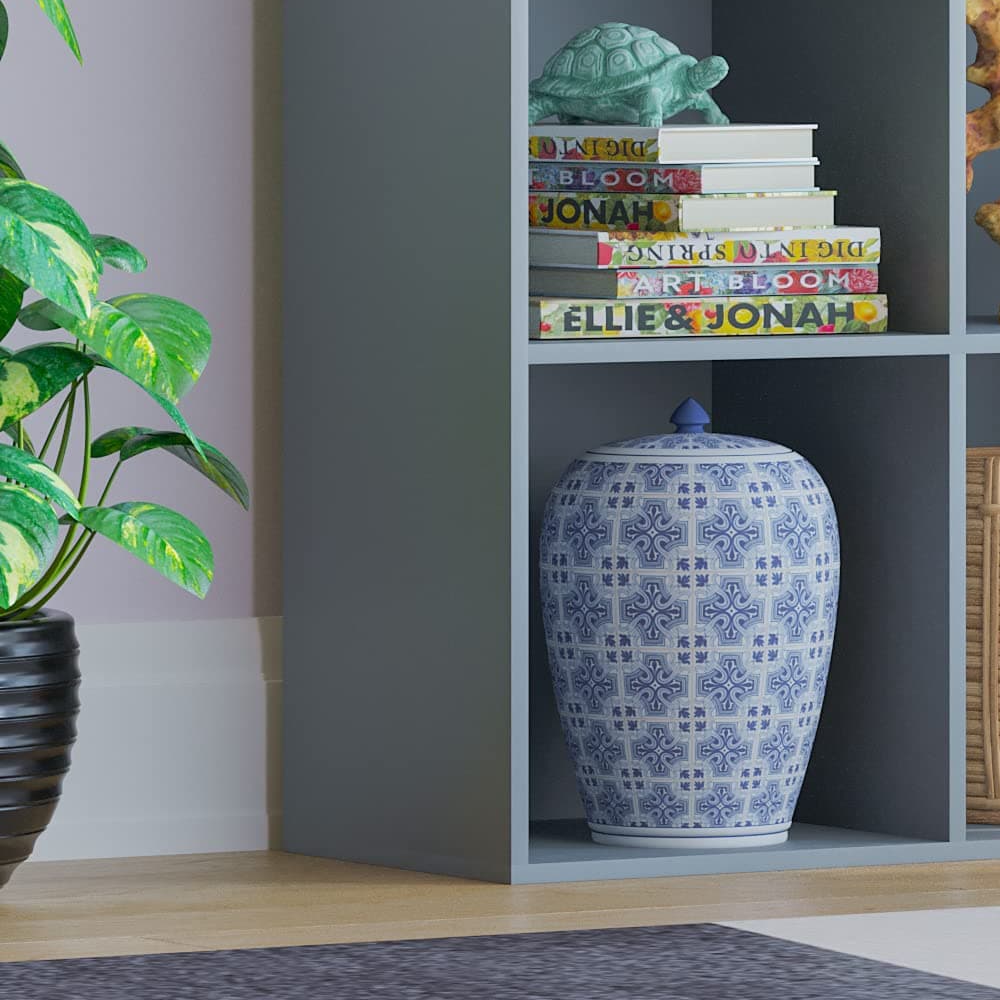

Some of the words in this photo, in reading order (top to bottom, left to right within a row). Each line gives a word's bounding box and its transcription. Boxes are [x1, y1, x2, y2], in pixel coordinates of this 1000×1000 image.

[542, 138, 599, 156] INTO
[605, 140, 645, 158] DIG
[558, 168, 675, 187] BLOOM
[541, 197, 654, 226] JONAH
[626, 243, 726, 262] SPRING
[741, 241, 808, 260] INTO
[816, 240, 864, 259] DIG
[633, 273, 706, 294] ART
[728, 272, 851, 292] BLOOM
[563, 304, 656, 332] ELLIE
[664, 304, 693, 331] &
[706, 301, 856, 331] JONAH
